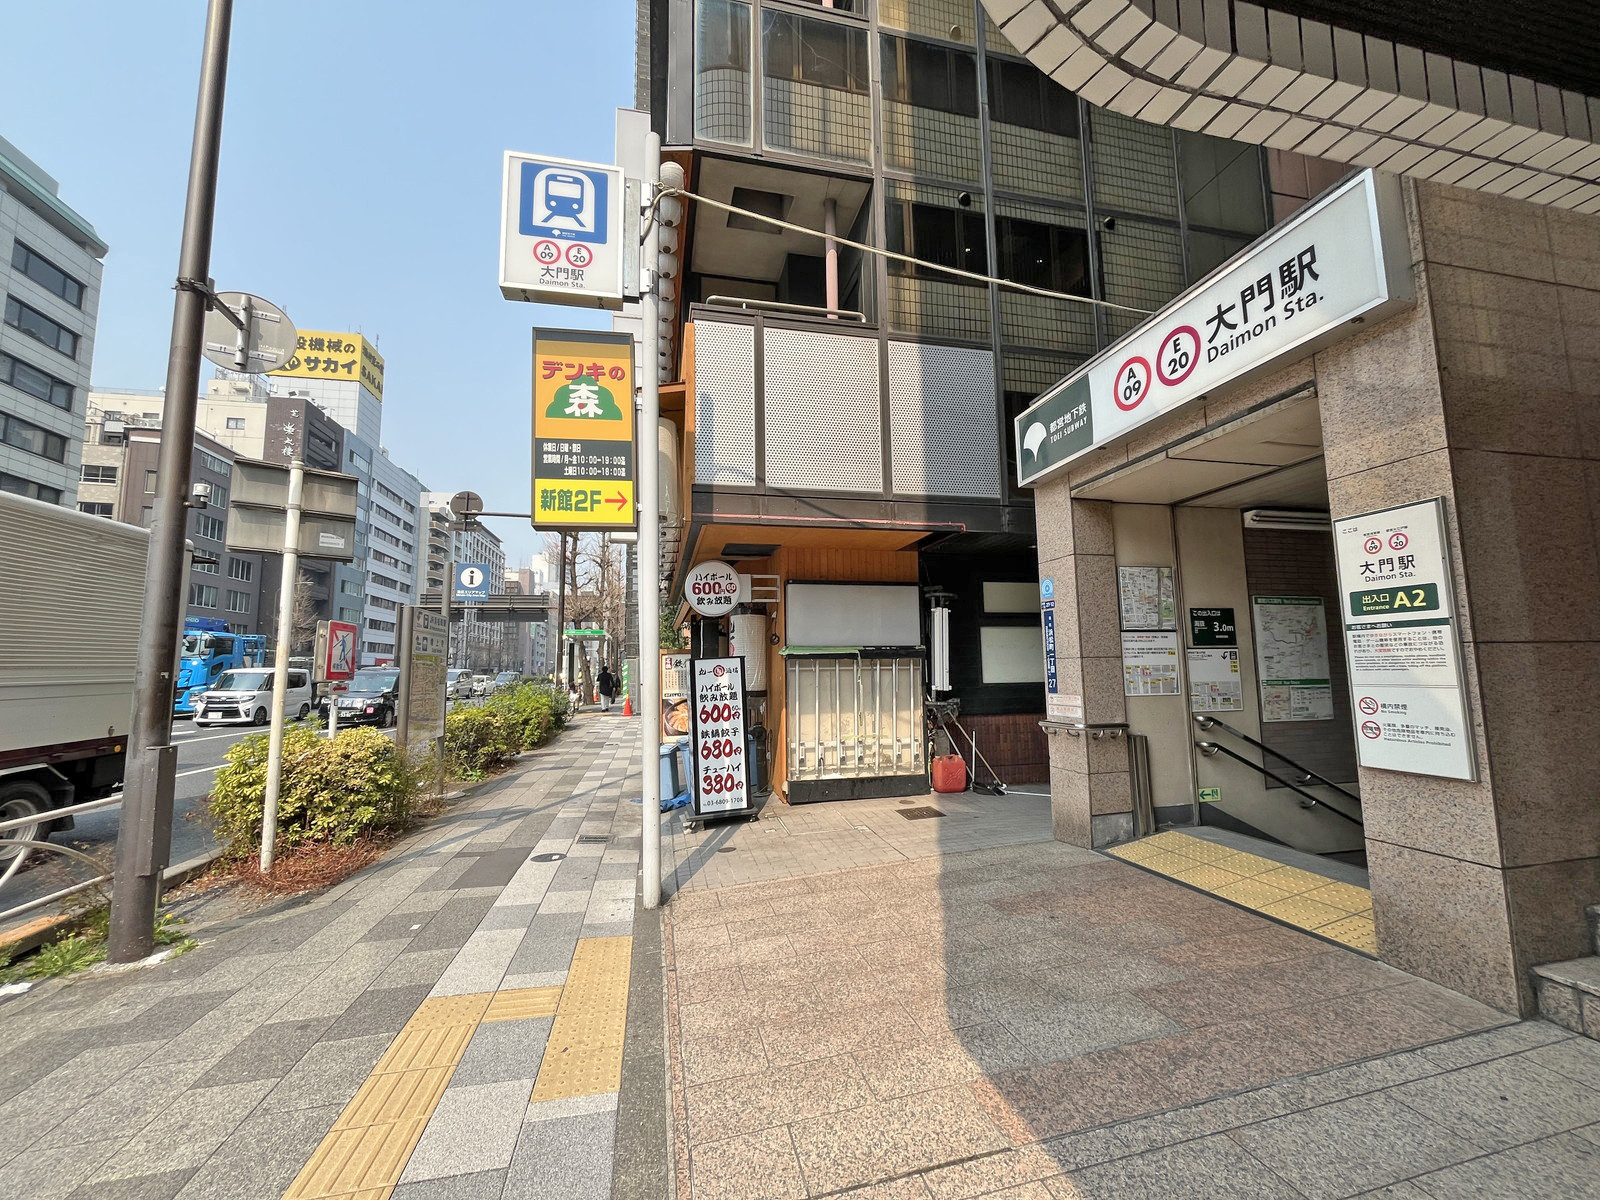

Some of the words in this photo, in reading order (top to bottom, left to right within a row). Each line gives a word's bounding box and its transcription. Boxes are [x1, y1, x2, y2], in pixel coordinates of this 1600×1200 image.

[540, 252, 554, 260] 09
[572, 255, 586, 263] 20
[540, 266, 584, 281] 大門駅
[540, 278, 568, 286] Daimon
[1206, 244, 1320, 344] 大門駅
[1208, 314, 1277, 363] Daimon
[1284, 294, 1324, 320] Sta.
[1173, 337, 1182, 352] E
[304, 356, 358, 374] サカイ
[542, 360, 626, 382] デンキの
[1168, 351, 1190, 376] 20
[1126, 368, 1136, 382] A
[1124, 380, 1142, 402] 09
[564, 383, 604, 418] 森
[1050, 402, 1086, 433] 都営地下鉄
[1050, 431, 1062, 443] TOEI
[1064, 416, 1087, 436] SUBWAY
[541, 489, 601, 512] 新館2F
[1360, 554, 1416, 575] 大門駅
[696, 573, 732, 581] ハイボール
[1365, 574, 1396, 582] Daimon
[697, 596, 732, 606] 飲み放題
[1362, 594, 1390, 604] 出入口
[1394, 590, 1426, 608] A2
[1214, 622, 1234, 632] 3.0m
[701, 683, 734, 692] ハイボール
[1048, 679, 1056, 688] 27
[700, 692, 738, 702] 飲み放題
[700, 704, 740, 724] 600円
[701, 727, 739, 739] 鉄鍋餃子
[701, 739, 742, 760] 680円
[704, 763, 741, 774] チューハイ
[702, 773, 744, 795] 380円
